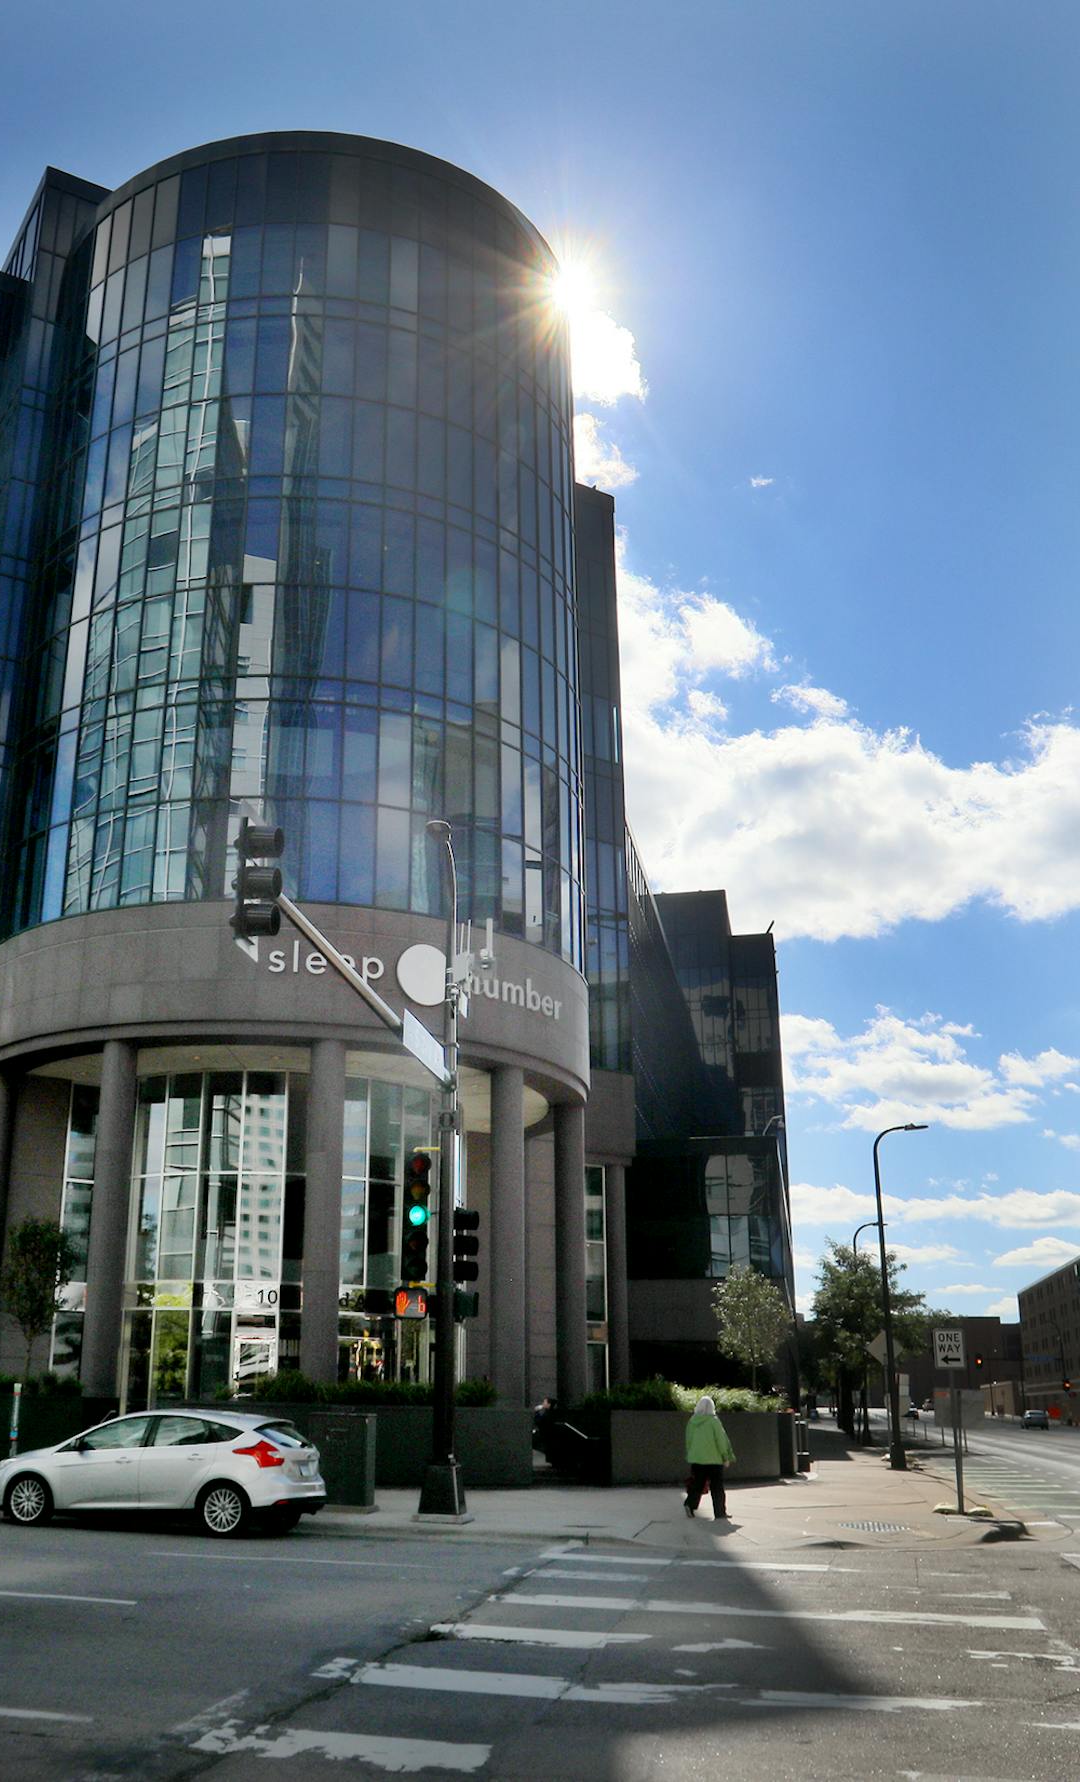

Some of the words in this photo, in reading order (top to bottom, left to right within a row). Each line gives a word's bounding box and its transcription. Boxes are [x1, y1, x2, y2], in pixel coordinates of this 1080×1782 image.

[464, 974, 562, 1019] number
[938, 1332, 960, 1342] ONE
[938, 1343, 961, 1353] WAY
